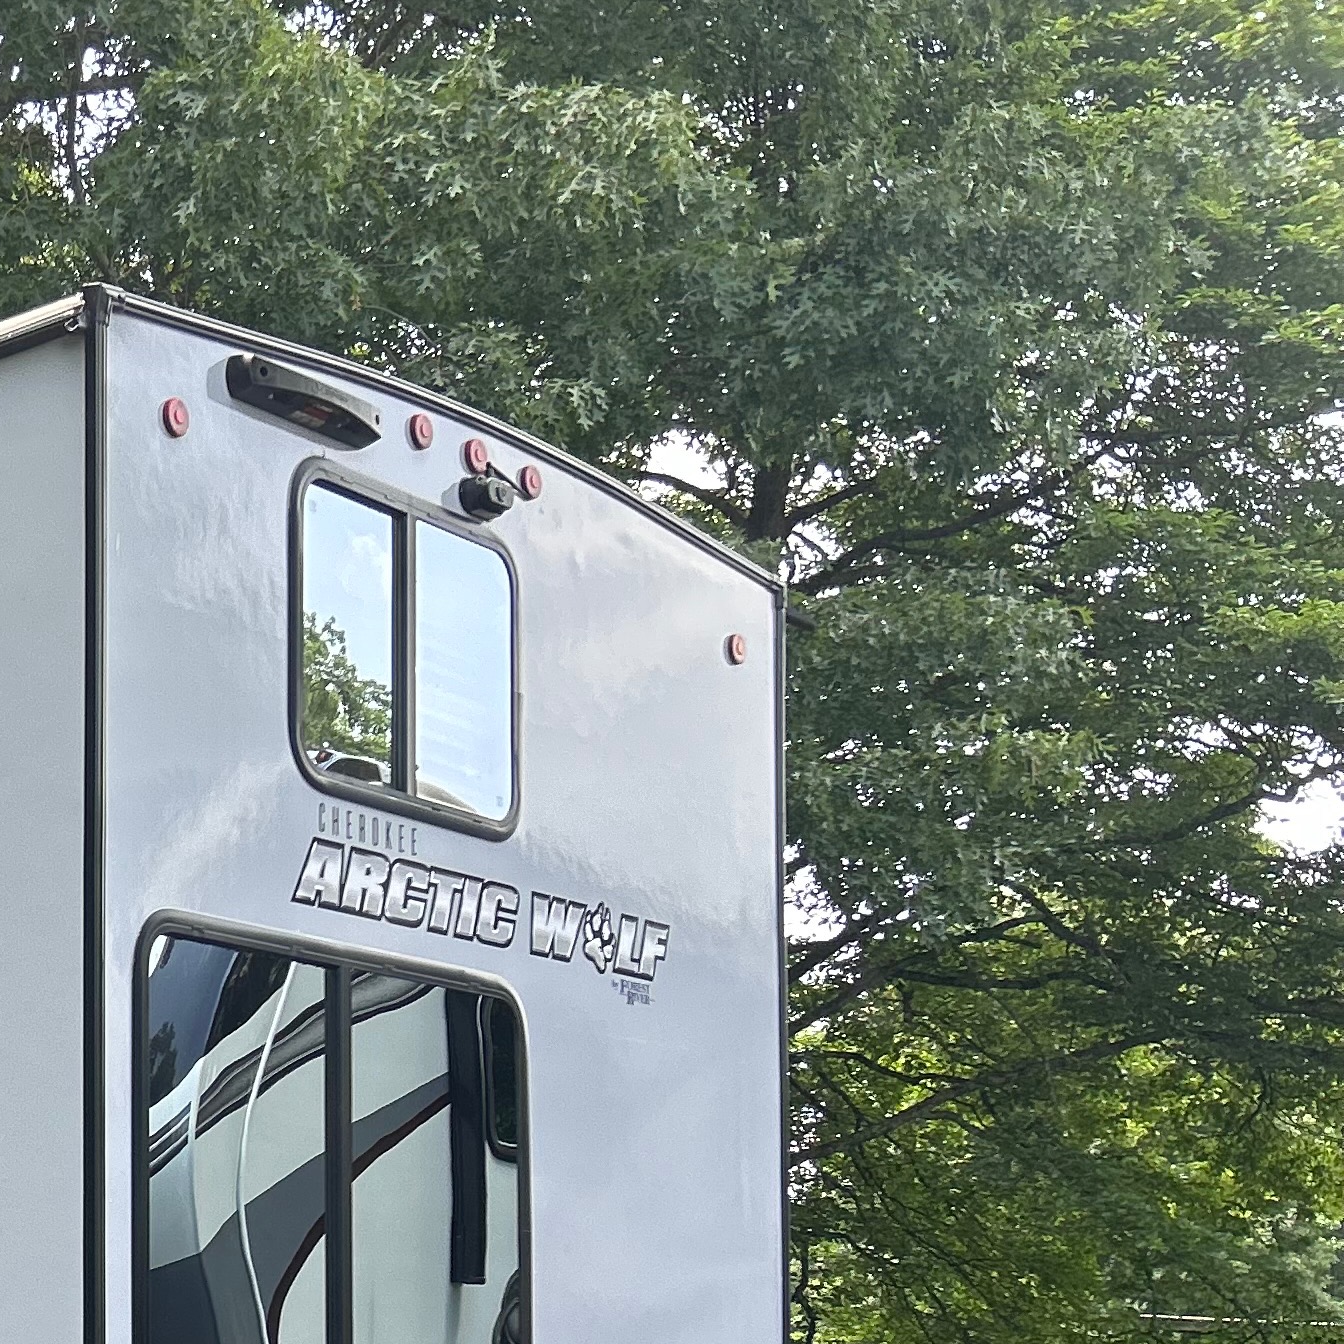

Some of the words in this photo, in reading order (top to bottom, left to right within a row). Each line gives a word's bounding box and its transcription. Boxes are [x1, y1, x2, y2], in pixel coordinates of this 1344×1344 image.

[317, 802, 418, 856] CHEROKEE
[291, 836, 521, 949] ARCTIC
[529, 890, 671, 981] WLF
